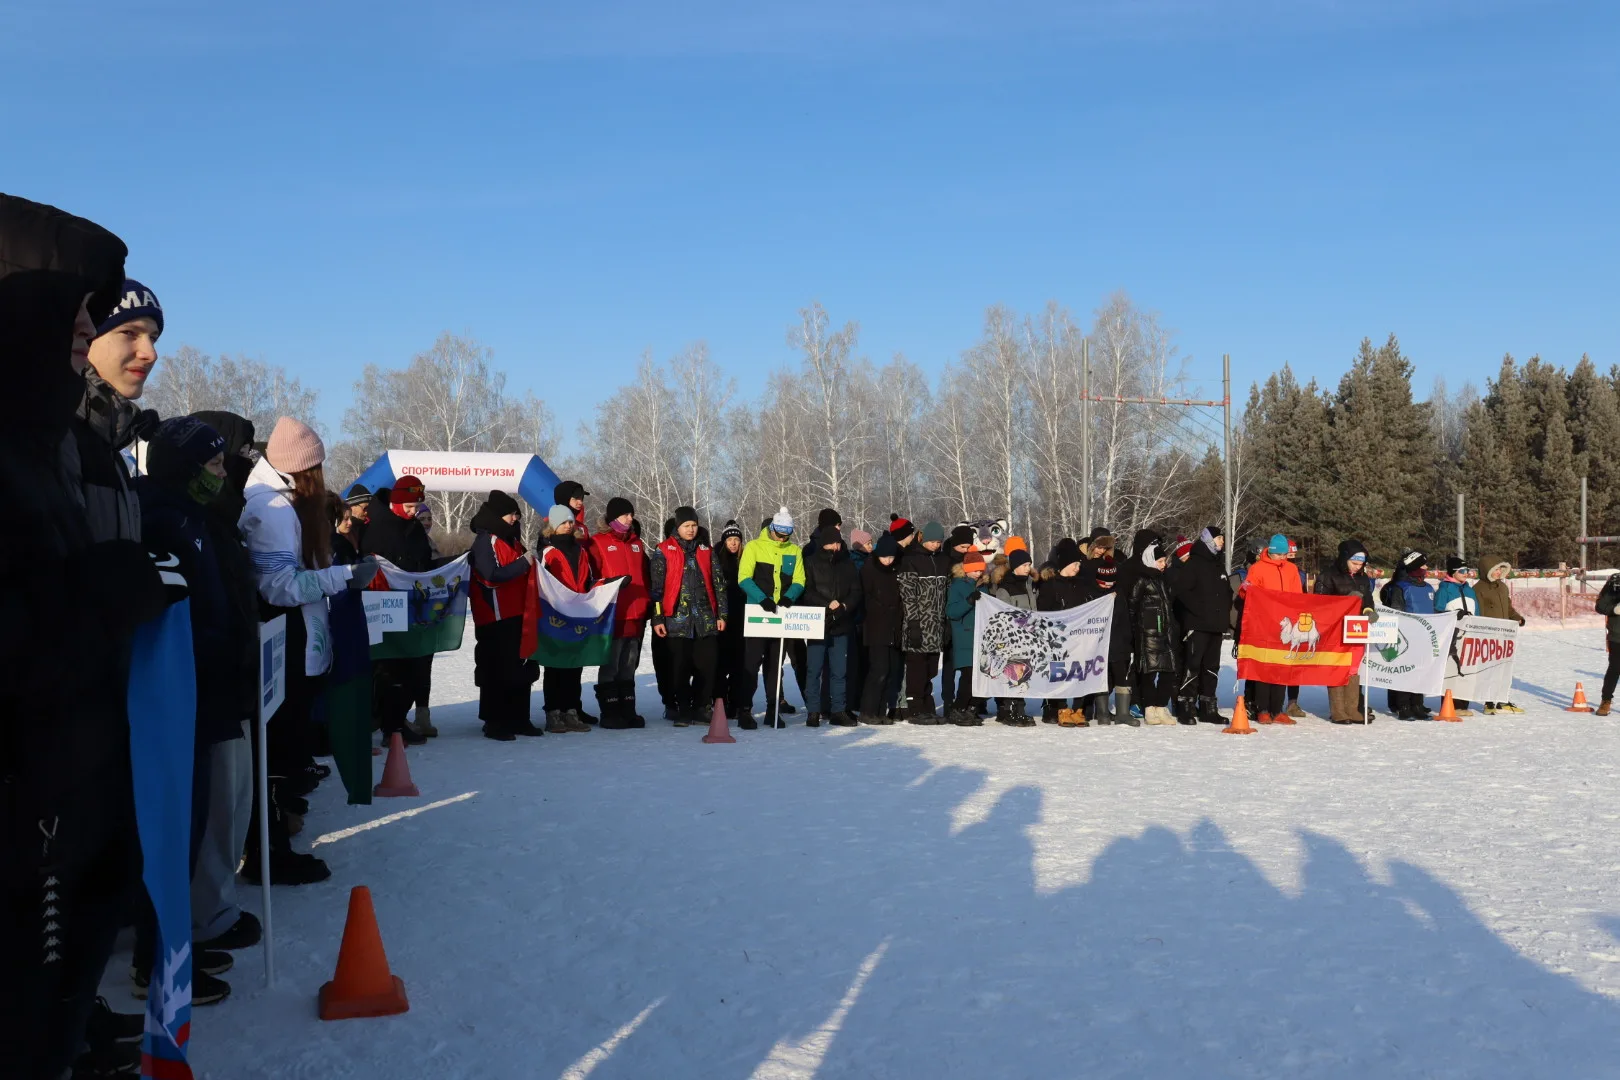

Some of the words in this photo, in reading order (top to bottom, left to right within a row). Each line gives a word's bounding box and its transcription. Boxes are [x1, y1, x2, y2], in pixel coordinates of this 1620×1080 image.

[401, 466, 471, 476] СПОРТИВНЫЙ
[473, 467, 515, 477] ТУРИЗМ
[380, 598, 404, 609] НСКАЯ
[381, 613, 394, 624] СТЬ
[784, 612, 822, 621] КУРГАНСКАЯ
[1087, 616, 1109, 625] ВОЕНН
[784, 623, 810, 632] ОБЛАСТЬ
[1069, 627, 1105, 636] СПОРТИВН
[1460, 637, 1514, 667] ПРОРЫВ
[1049, 655, 1105, 683] БАРС
[1375, 676, 1393, 684] МИАСС
